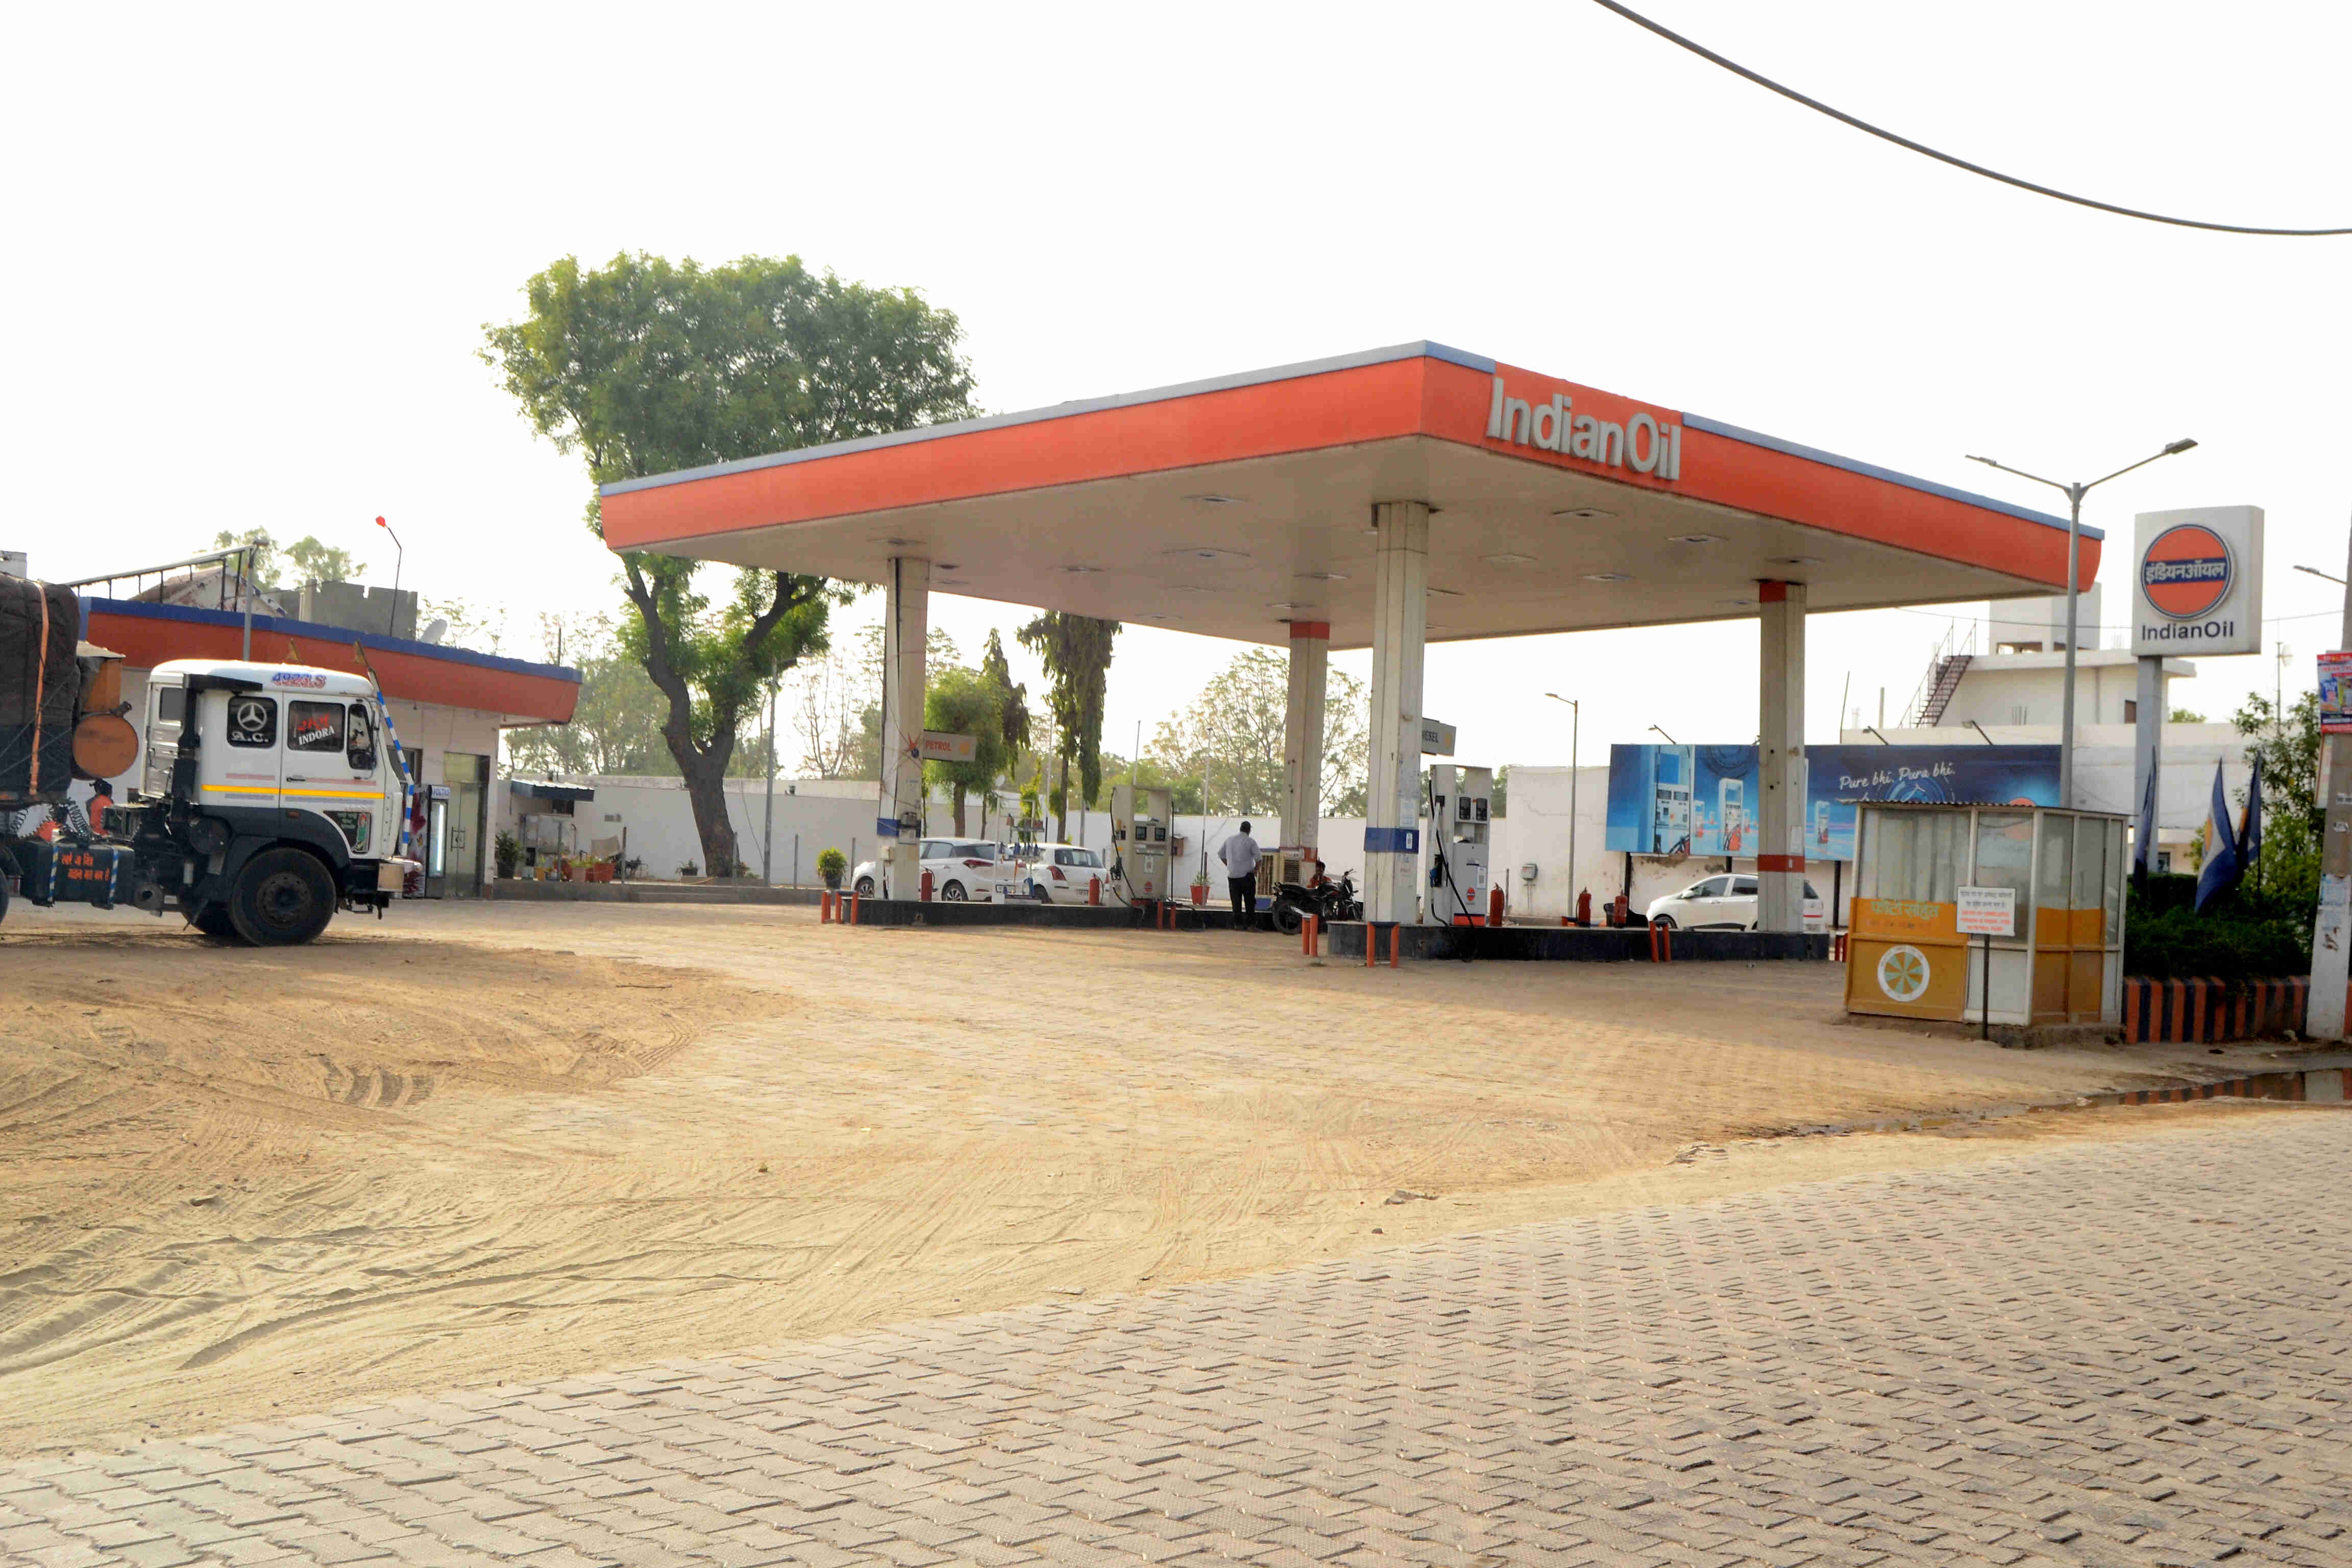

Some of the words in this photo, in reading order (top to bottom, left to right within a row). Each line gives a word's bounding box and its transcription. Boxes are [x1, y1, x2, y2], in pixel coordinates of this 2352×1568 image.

[1486, 377, 1681, 481] IndianOil
[2145, 559, 2226, 585] इंडियनऑयल
[2142, 621, 2234, 640] IndianOil
[298, 725, 335, 746] INDORA
[925, 739, 952, 752] PETROL
[1840, 775, 1870, 790] Pure
[1872, 770, 1894, 786] bhi.
[1898, 767, 1930, 781] Pura
[1933, 762, 1956, 777] bhi.
